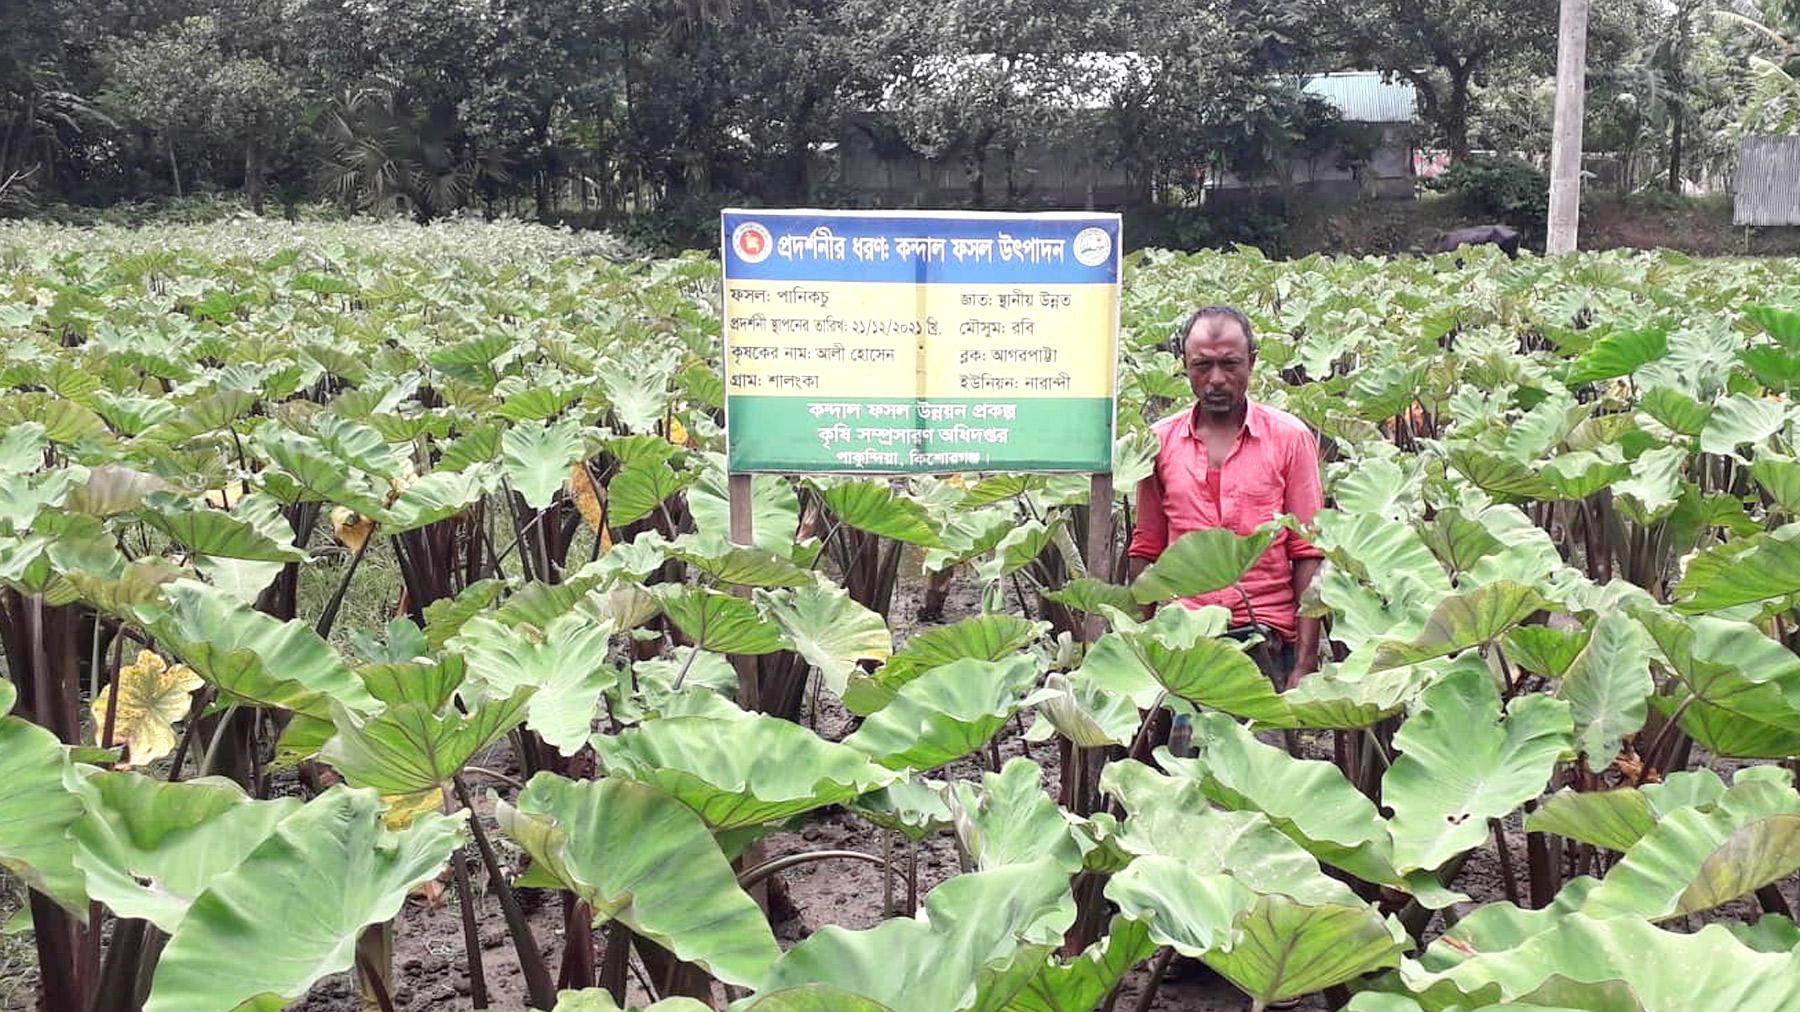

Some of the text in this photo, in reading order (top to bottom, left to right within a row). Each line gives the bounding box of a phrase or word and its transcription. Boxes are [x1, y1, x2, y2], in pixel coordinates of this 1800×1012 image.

[778, 226, 846, 260] প্রদর্শনীর
[895, 235, 947, 263] কন্দাল
[951, 238, 994, 263] ফসল
[997, 231, 1065, 263] উৎপাদন
[777, 286, 830, 308] পানিকচু
[997, 289, 1033, 309] স্থানীয়
[1039, 291, 1071, 309] উন্নত
[771, 318, 809, 334] স্থাপনের
[852, 319, 923, 336] ২১/১২/২০২১
[1012, 318, 1035, 335] রবি
[731, 346, 778, 364] কৃষকের
[816, 343, 845, 360] আলী
[851, 348, 895, 361] হোসেন
[768, 375, 819, 389] শালংকা
[1025, 372, 1071, 390] নারান্দী
[807, 401, 1017, 421] কন্দাল ফসল উন্নয়ন প্রকল্প
[818, 423, 1009, 449] কৃষি সম্প্রসারণ অধিদপ্তর
